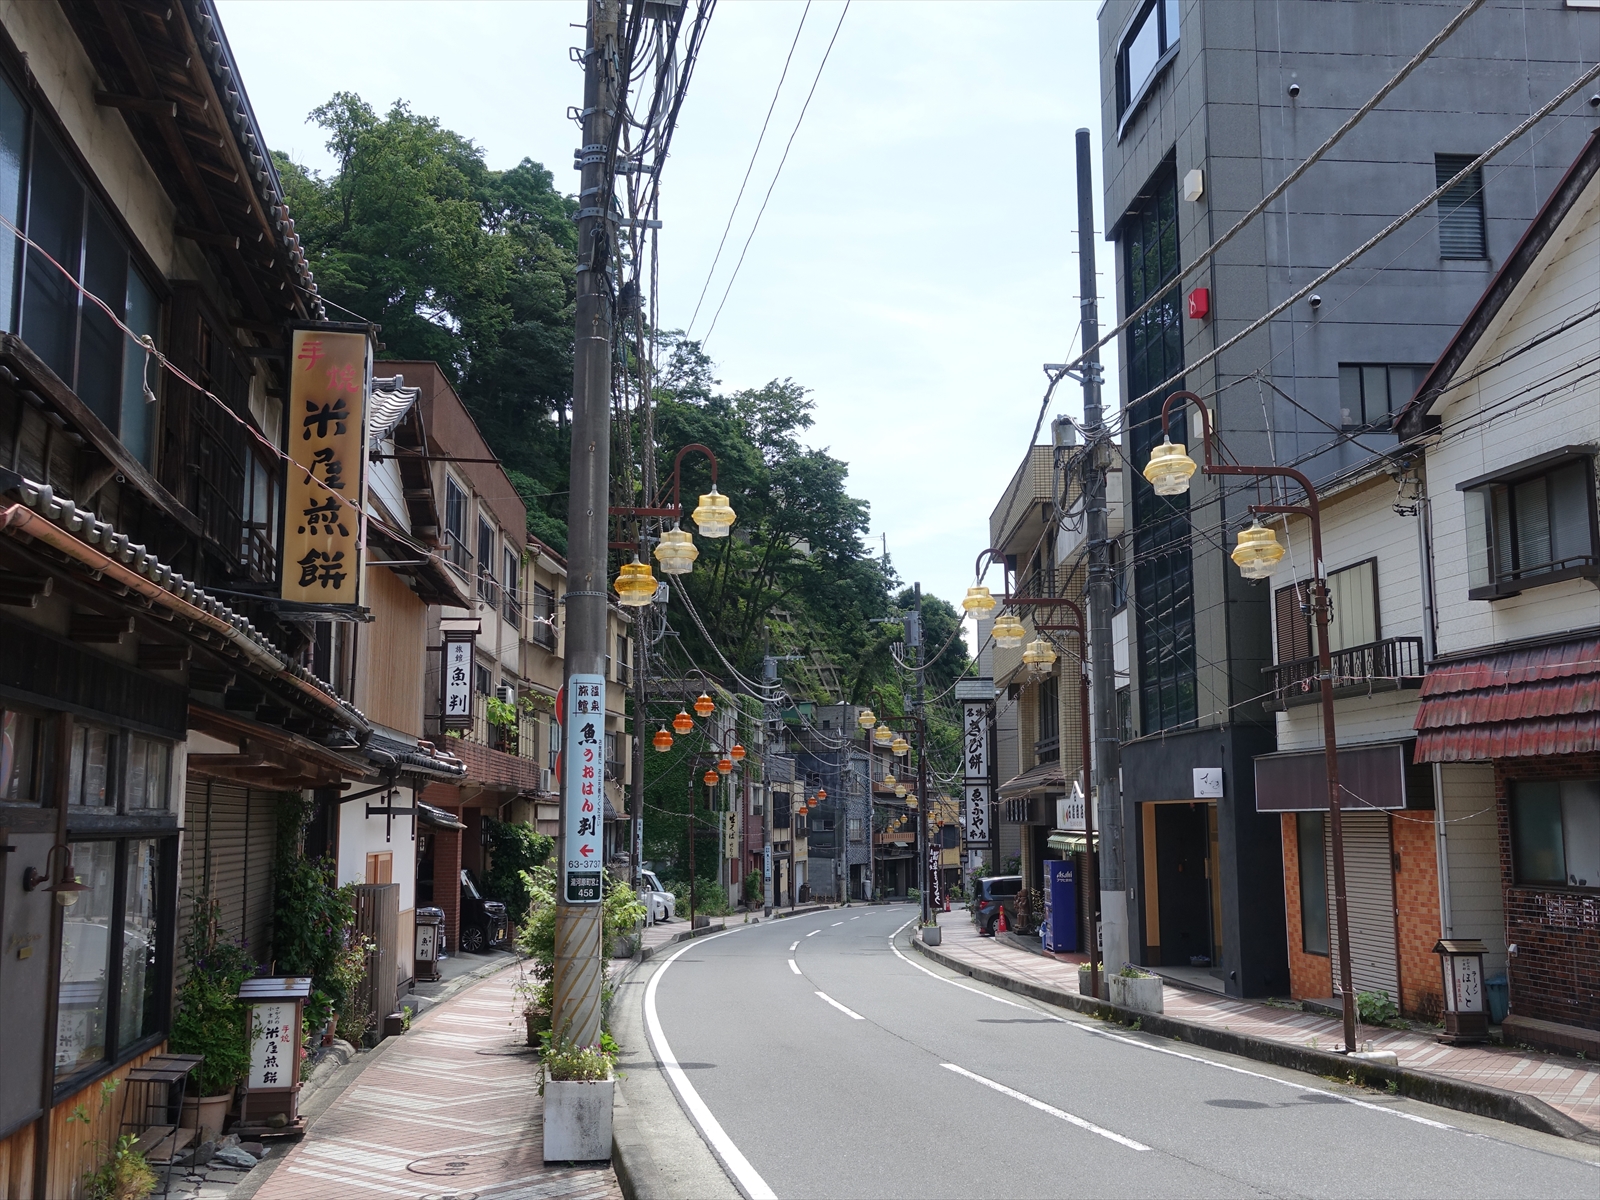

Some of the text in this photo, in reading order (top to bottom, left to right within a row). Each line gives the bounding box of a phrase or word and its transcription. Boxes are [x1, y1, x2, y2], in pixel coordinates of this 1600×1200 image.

[297, 341, 360, 393] 手焼
[297, 399, 350, 590] 米屋煎餅
[455, 644, 463, 662] 旅館
[449, 667, 467, 713] 魚判
[577, 685, 589, 711] 旅館
[590, 685, 600, 711] 温泉
[968, 718, 984, 775] きび餅
[568, 860, 601, 869] 63-3737
[1056, 870, 1073, 878] Asahi
[578, 888, 594, 898] 458
[1462, 973, 1472, 1008] ほくと
[1471, 970, 1479, 995] ラーメン
[281, 1024, 290, 1043] 手焼
[263, 1027, 279, 1084] 米屋煎餅
